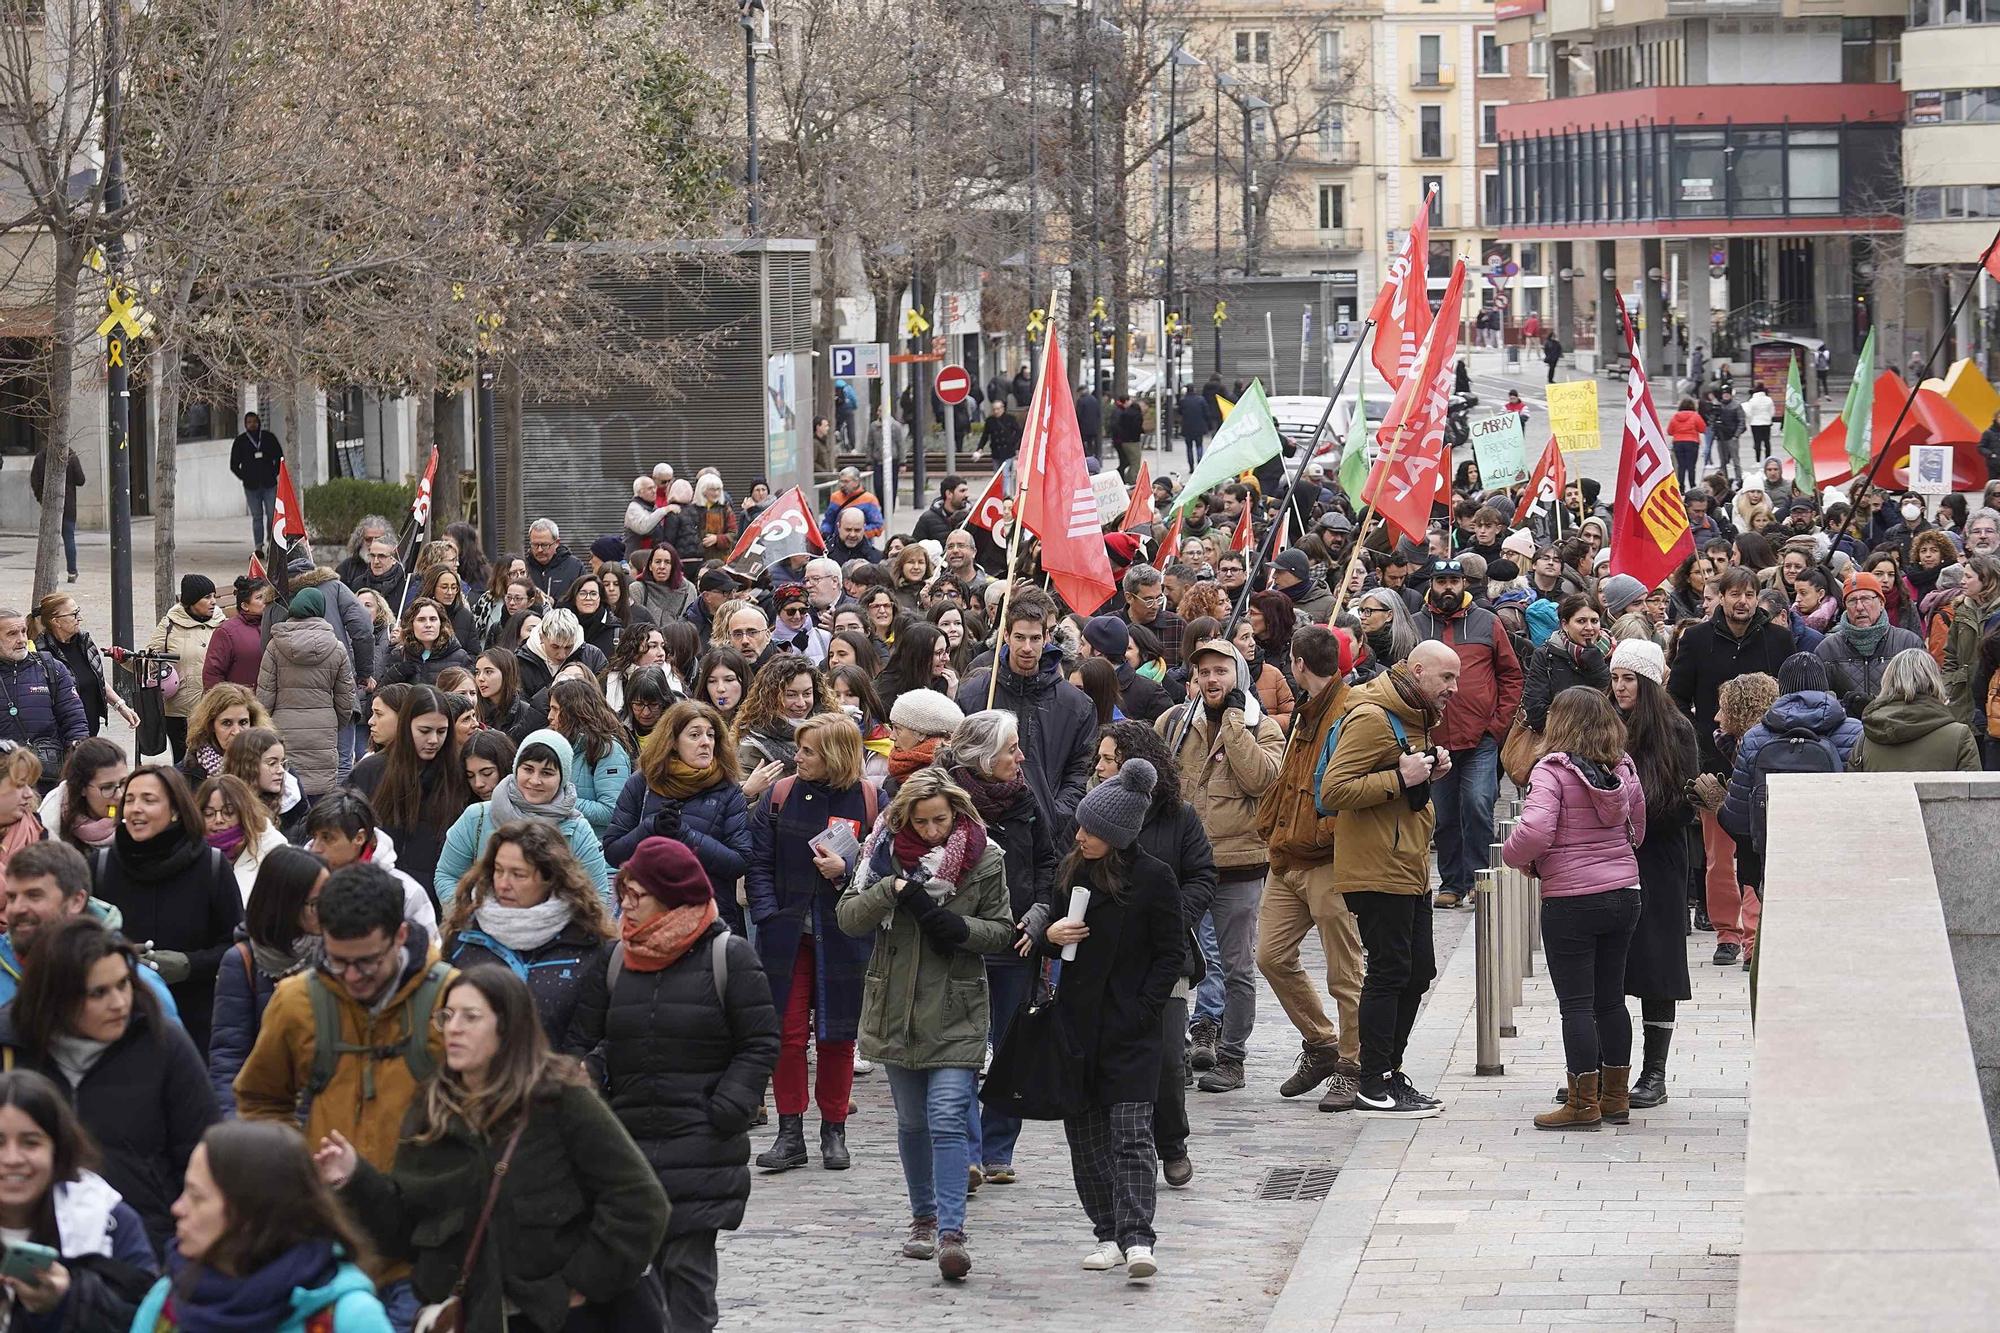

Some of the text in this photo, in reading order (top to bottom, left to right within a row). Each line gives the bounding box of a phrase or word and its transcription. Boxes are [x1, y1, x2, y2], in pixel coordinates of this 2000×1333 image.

[836, 350, 853, 374] P
[1472, 414, 1515, 437] CAMBRAY
[1493, 466, 1512, 479] CUL
